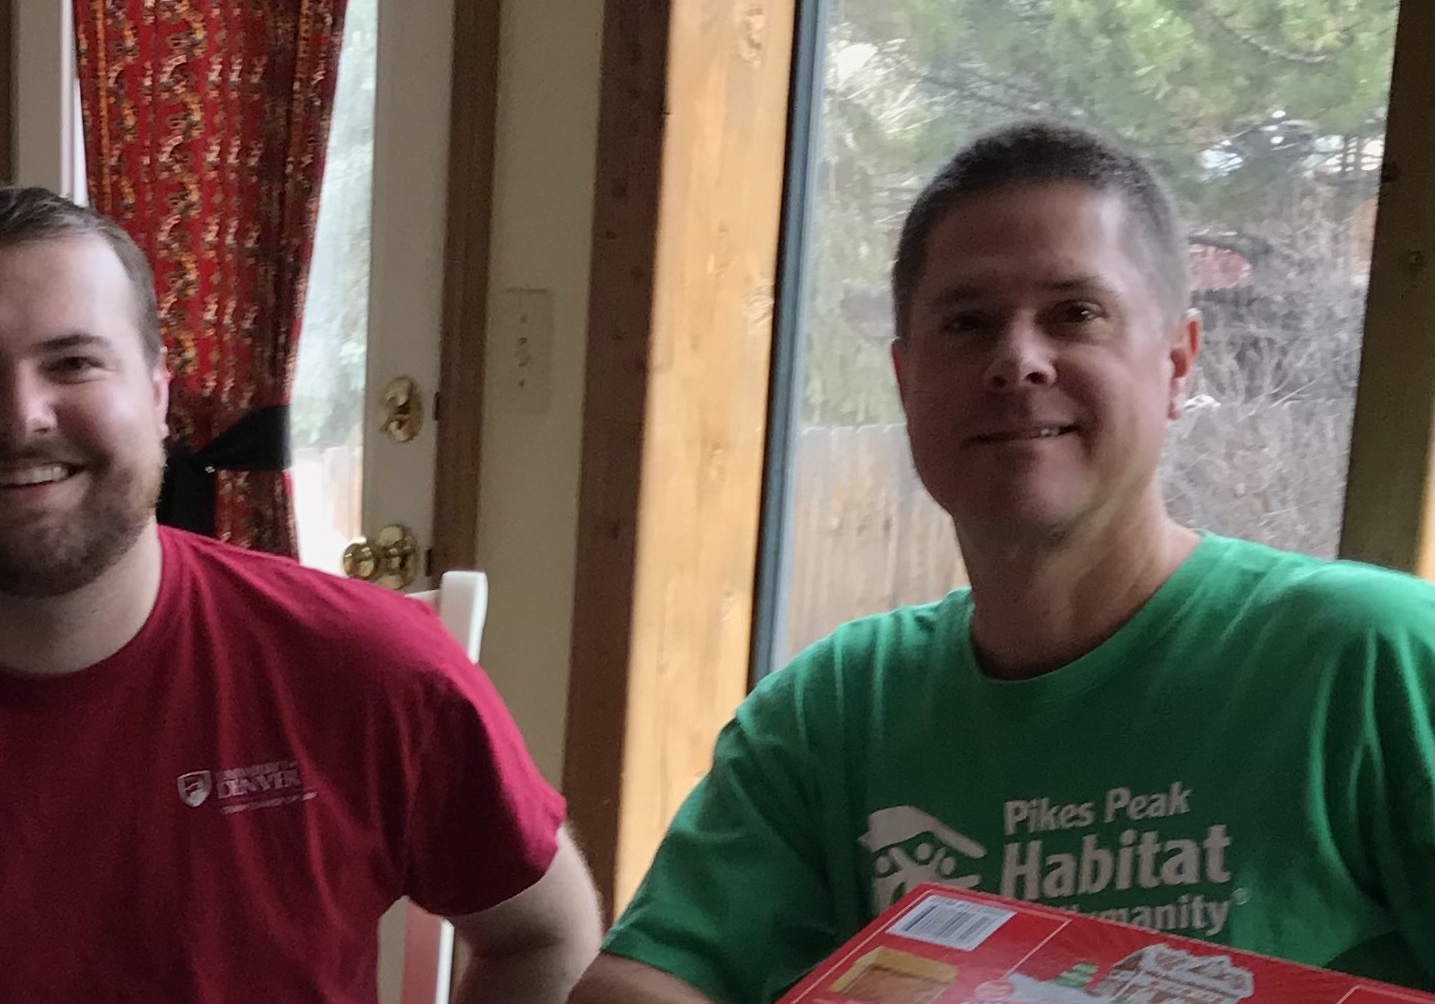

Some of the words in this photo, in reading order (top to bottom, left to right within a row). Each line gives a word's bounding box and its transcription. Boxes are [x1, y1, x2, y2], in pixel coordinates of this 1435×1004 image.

[1004, 797, 1095, 835] Pikes
[1104, 781, 1194, 823] Peak
[1001, 824, 1233, 901] Habitat
